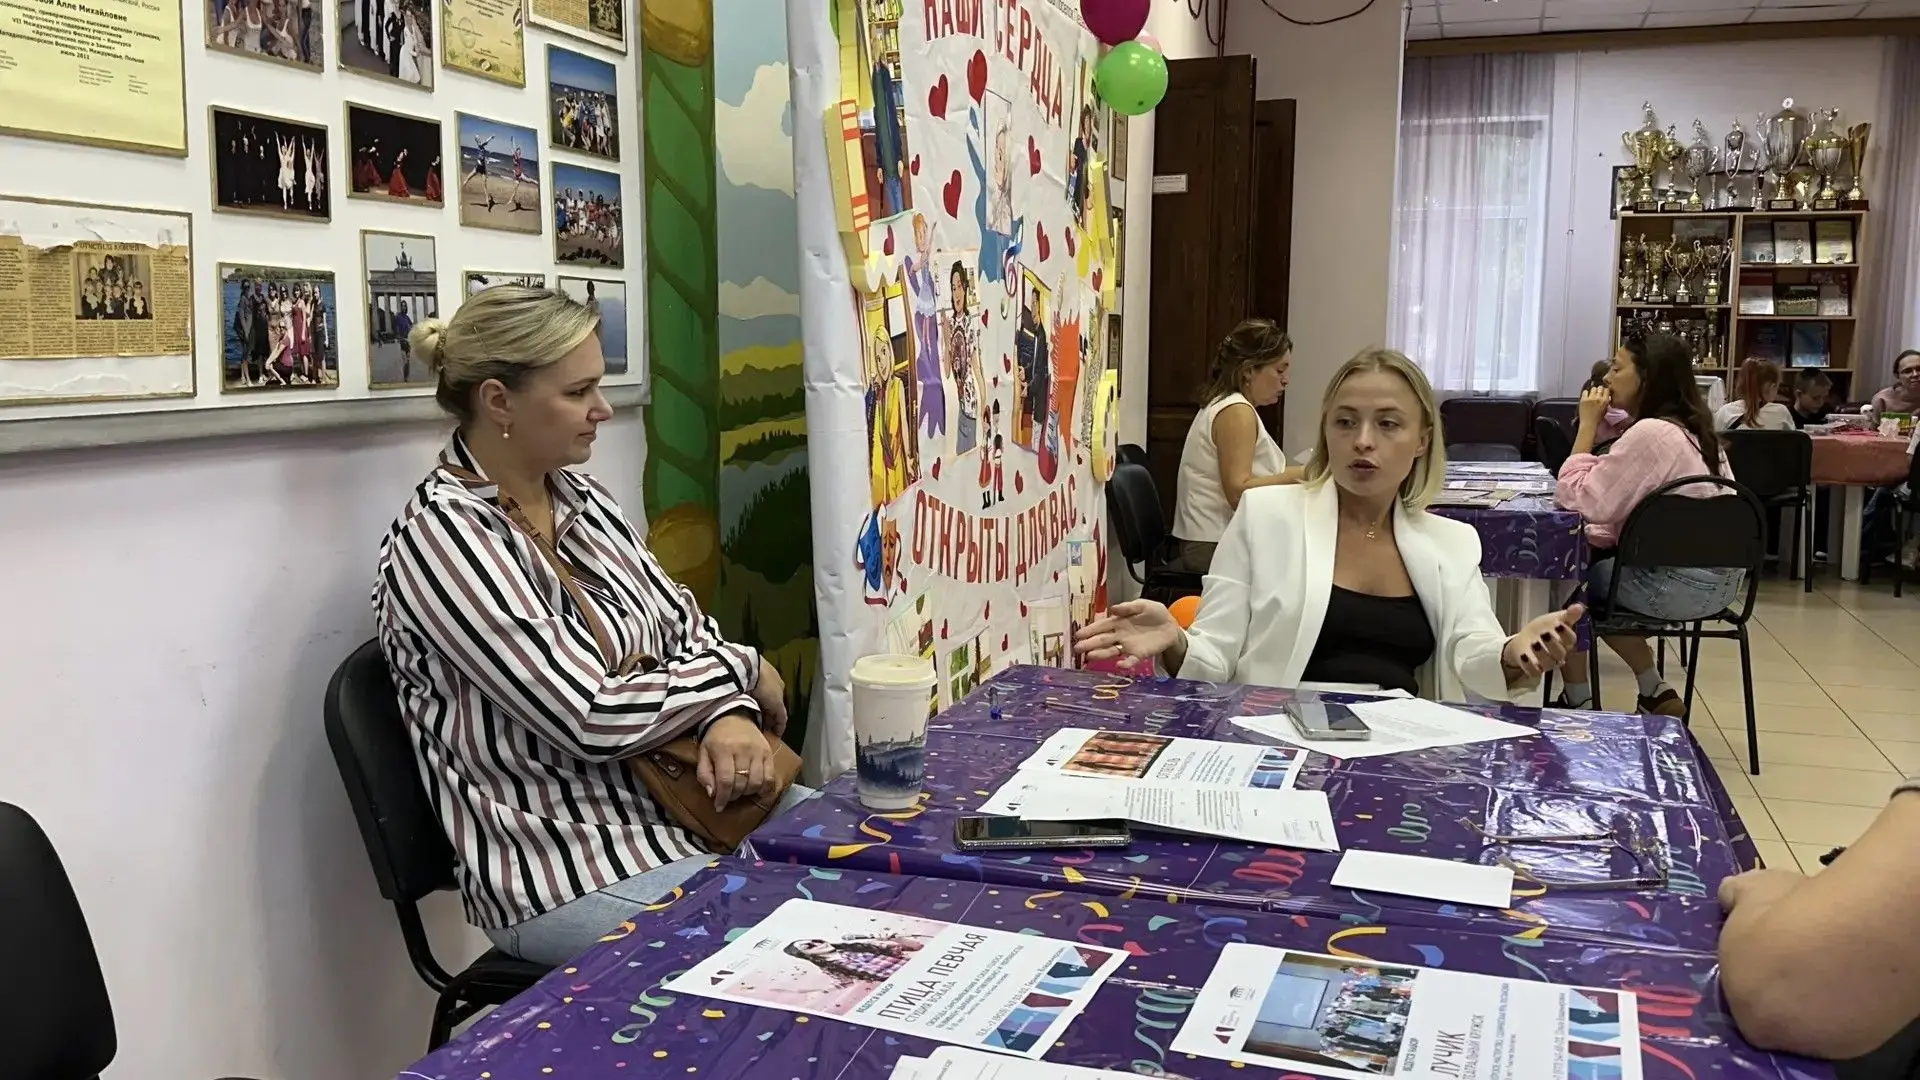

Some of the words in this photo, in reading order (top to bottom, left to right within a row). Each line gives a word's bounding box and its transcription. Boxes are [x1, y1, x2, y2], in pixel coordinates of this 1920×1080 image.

[56, 0, 77, 10] Алле
[79, 4, 127, 21] Михайловне
[994, 0, 1063, 128] СЕРДЦА
[912, 489, 1009, 583] ОТКРЫТЫ
[1016, 499, 1049, 587] ДЛЯ
[1049, 474, 1077, 549] ВАС
[875, 977, 944, 1020] ПТИЦА
[922, 932, 991, 976] ПЕВЧАЯ
[902, 1002, 934, 1022] СТУДИЯ
[925, 980, 958, 1002] ВОКАЛА
[1469, 1014, 1485, 1039] КРУЖОК
[1428, 1029, 1466, 1077] ЛУЧИК
